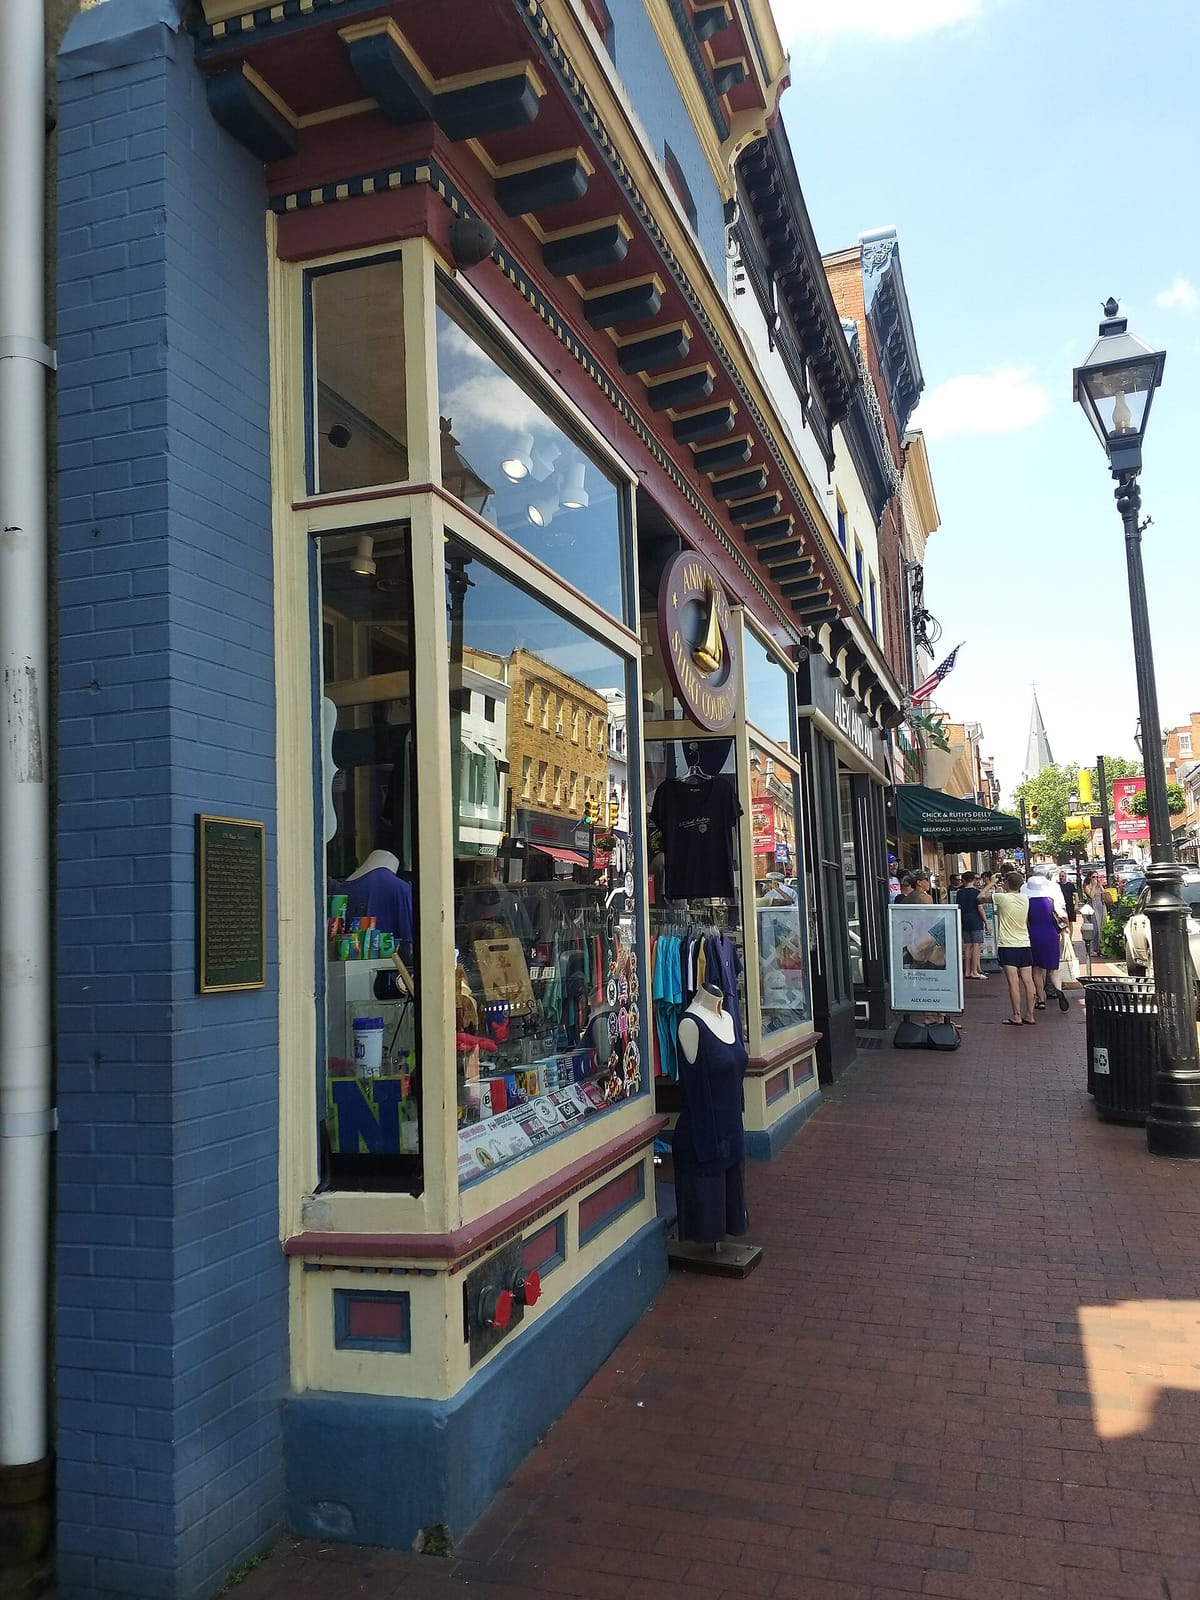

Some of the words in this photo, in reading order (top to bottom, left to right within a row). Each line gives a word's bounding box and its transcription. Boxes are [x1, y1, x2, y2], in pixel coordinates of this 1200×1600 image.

[671, 630, 701, 705] SHIRT
[834, 688, 851, 738] ALEX
[851, 708, 864, 750] AND
[332, 1078, 402, 1154] N
